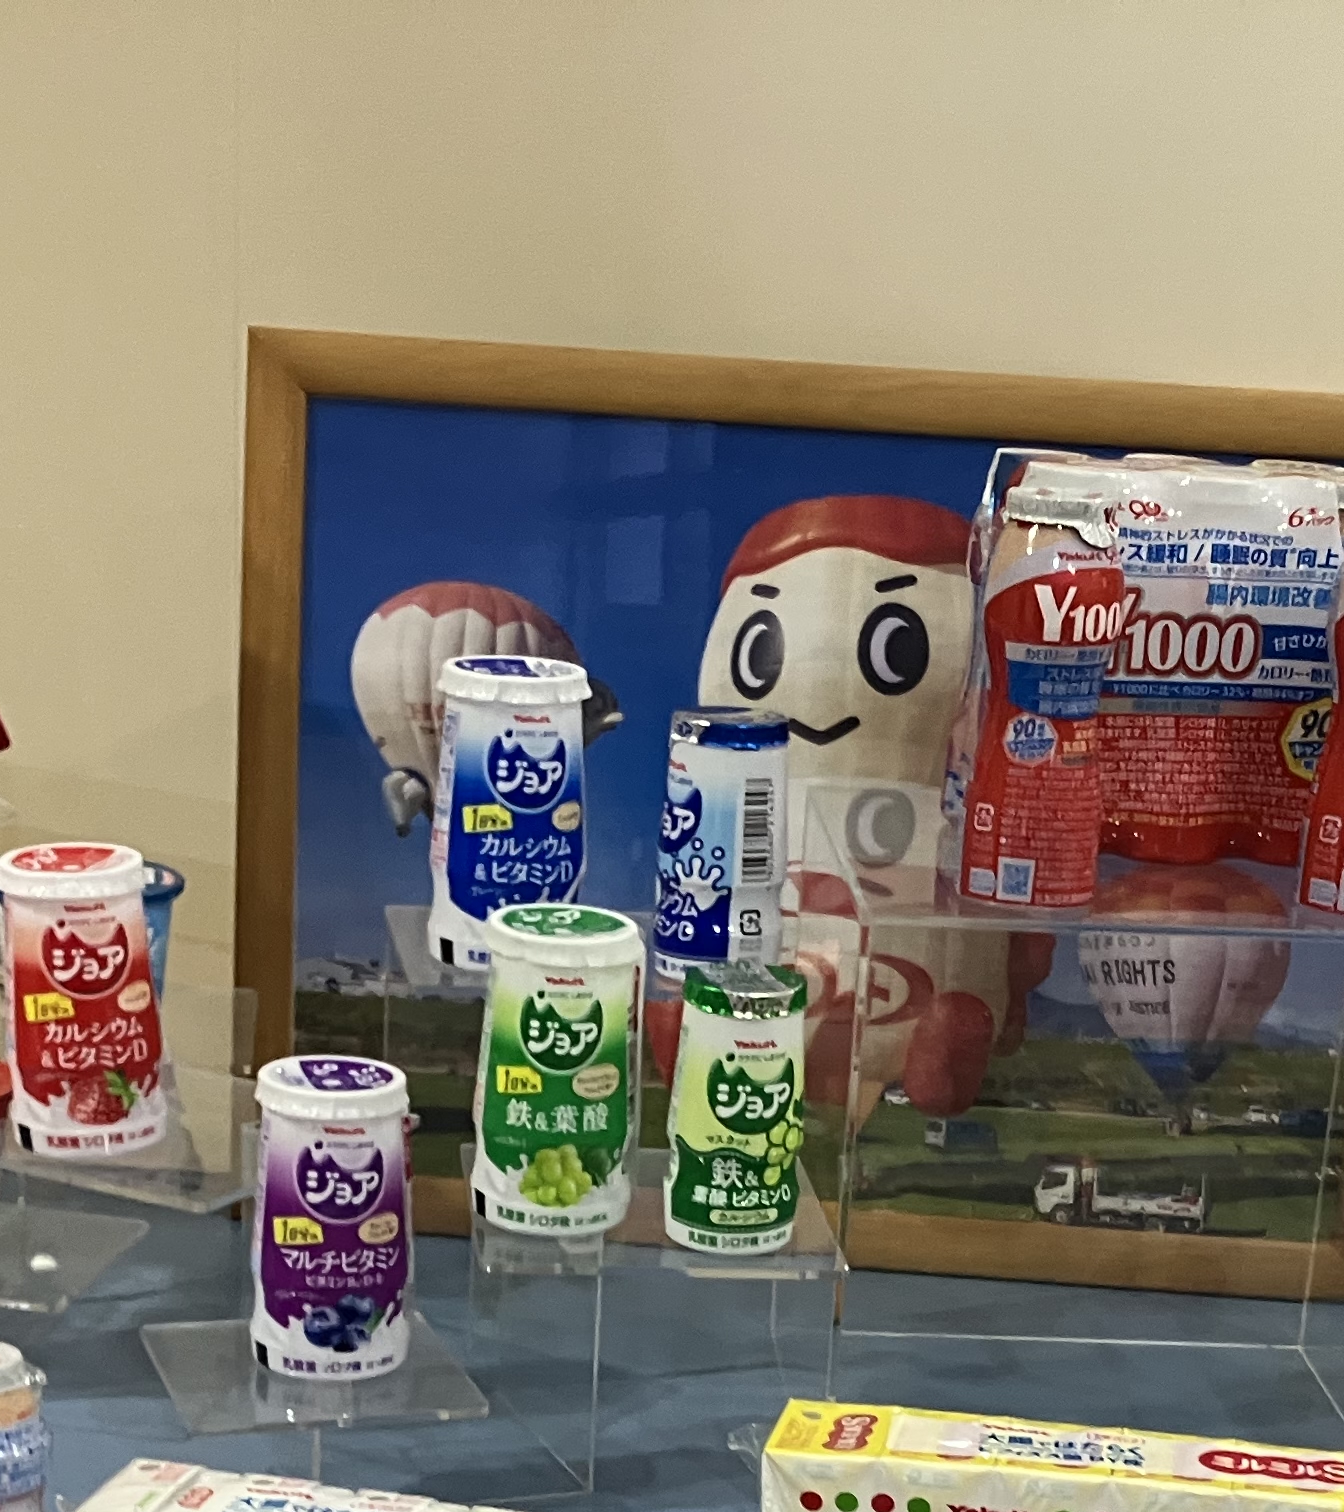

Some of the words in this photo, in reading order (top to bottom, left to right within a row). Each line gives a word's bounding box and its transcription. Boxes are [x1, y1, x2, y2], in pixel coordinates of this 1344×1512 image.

[496, 758, 563, 794] ジョア
[480, 833, 572, 860] カルシウム
[52, 945, 126, 983] ジョア
[1100, 959, 1177, 987] RIGHTS
[44, 1016, 144, 1045] カルシウム
[528, 1020, 599, 1056] ジョア
[716, 1082, 796, 1121] ジョア
[306, 1168, 379, 1206] ジョア
[279, 1247, 400, 1274] マルチビタミン
